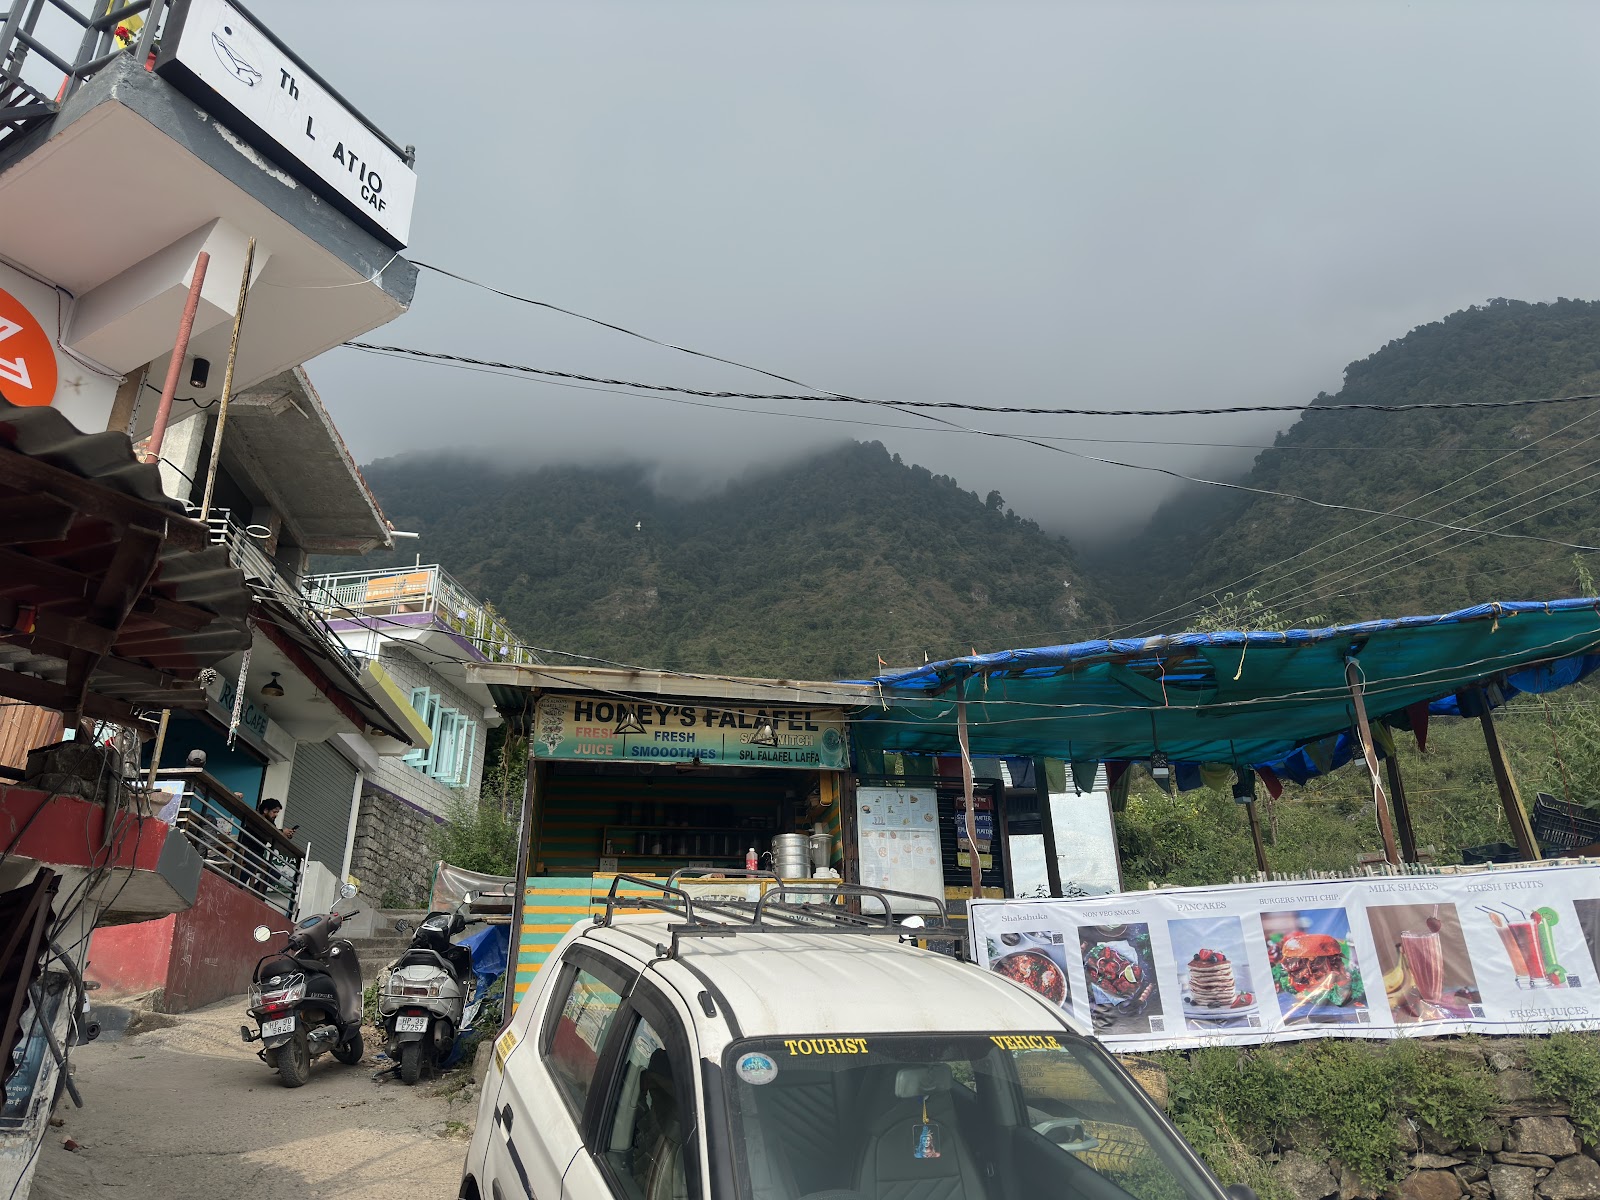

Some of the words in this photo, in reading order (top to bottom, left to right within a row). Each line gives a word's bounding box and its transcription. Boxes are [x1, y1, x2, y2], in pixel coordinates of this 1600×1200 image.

[280, 67, 300, 101] Th
[306, 115, 316, 141] L
[332, 141, 383, 194] ATIO
[361, 185, 387, 212] CAF
[574, 701, 697, 727] HONEY'S
[704, 709, 819, 732] FALAFEL
[575, 726, 618, 739] FRESH
[654, 731, 696, 743] FRESH
[573, 743, 614, 755] JUICE
[631, 745, 716, 759] SMOOOTHIES
[739, 750, 755, 761] SPL
[757, 751, 793, 762] FALAFEL
[795, 752, 820, 763] LAFFA
[1368, 884, 1396, 893] MILK
[1397, 882, 1439, 892] SHAKES
[1466, 883, 1502, 893] FRESH
[1503, 880, 1544, 890] FRUITS
[1259, 896, 1295, 905] BURGERS
[1296, 895, 1319, 903] WITH
[1114, 908, 1141, 917] SNACKS
[1176, 901, 1227, 912] PANCAKES
[1001, 912, 1048, 922] Shakshuka
[1509, 1008, 1547, 1018] FRESH
[1550, 1006, 1589, 1017] JUICES
[269, 1020, 279, 1029] HP
[784, 1038, 869, 1056] TOURIST
[989, 1035, 1062, 1050] VEHICLE
